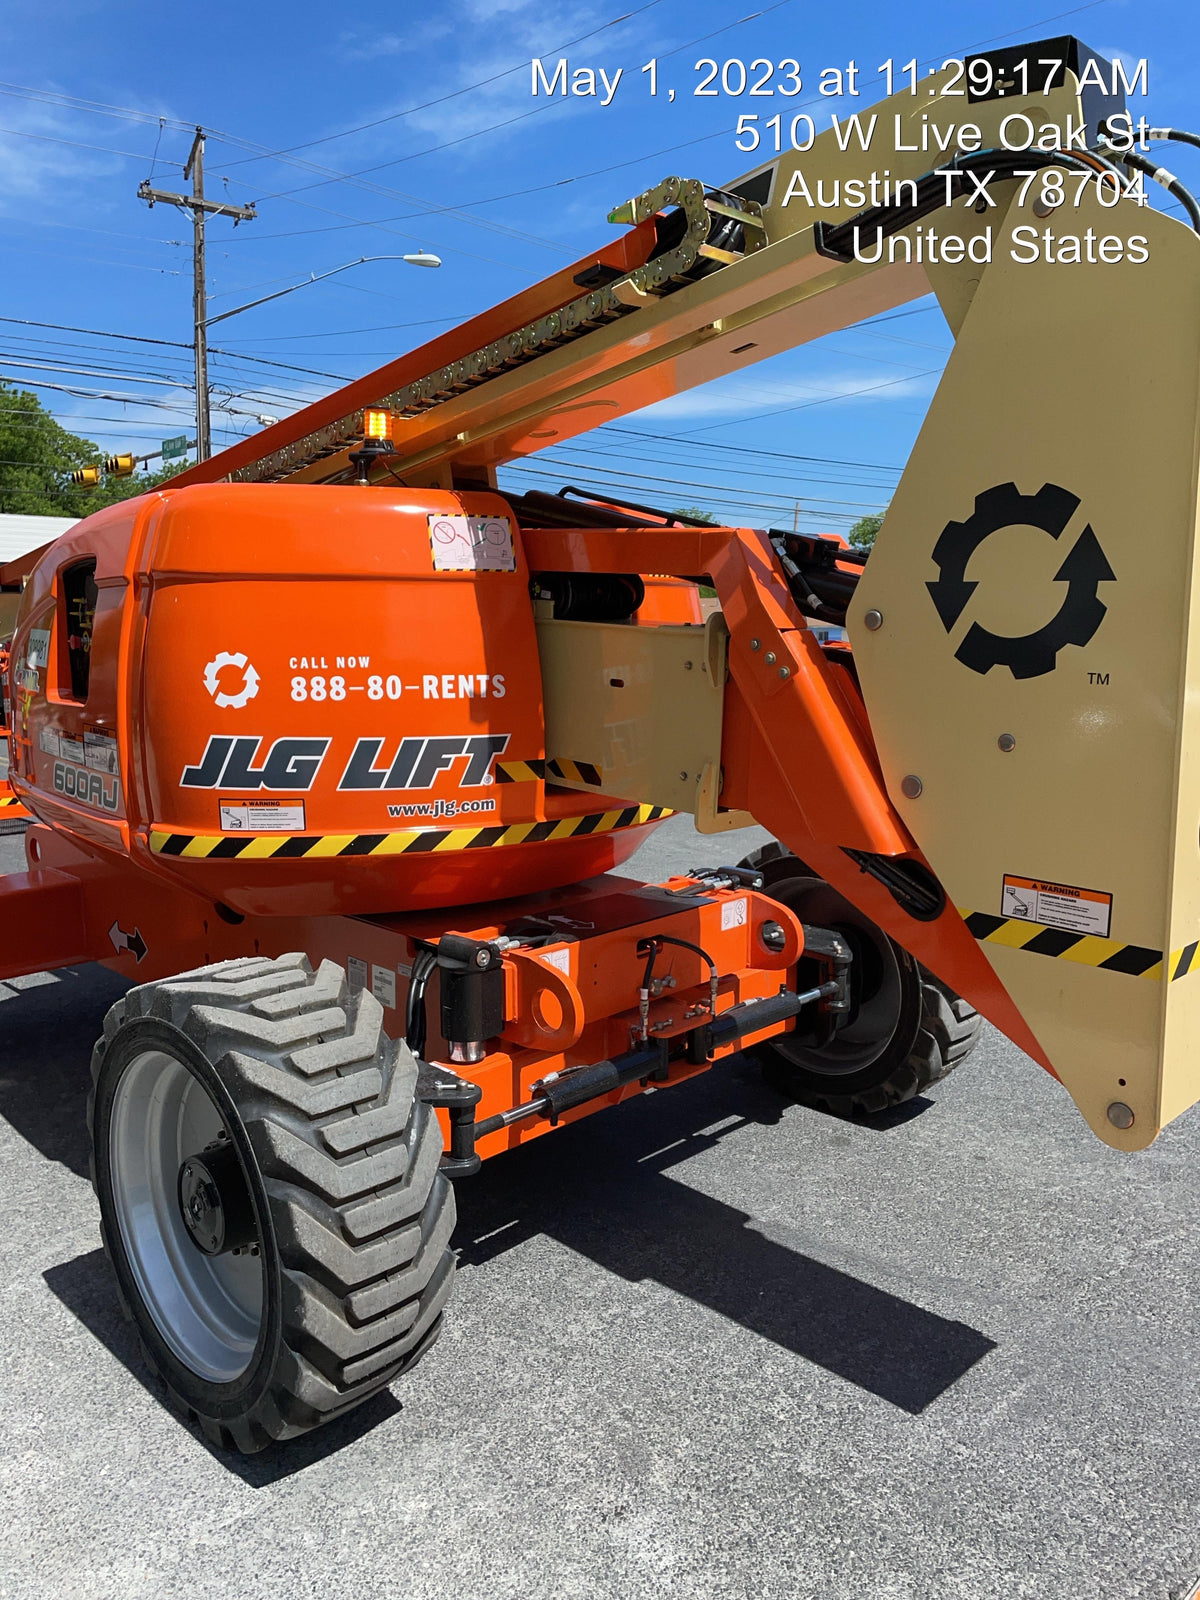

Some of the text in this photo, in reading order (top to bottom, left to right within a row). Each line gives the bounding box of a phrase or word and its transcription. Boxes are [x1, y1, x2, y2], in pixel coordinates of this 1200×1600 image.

[289, 656, 370, 669] CALL NOW
[290, 674, 506, 702] 888-80-RENTS
[1087, 672, 1110, 685] TM
[180, 735, 332, 791] JLG
[54, 760, 119, 812] 600AJ
[387, 799, 496, 819] www.jlg.com
[1040, 884, 1080, 897] WARNING
